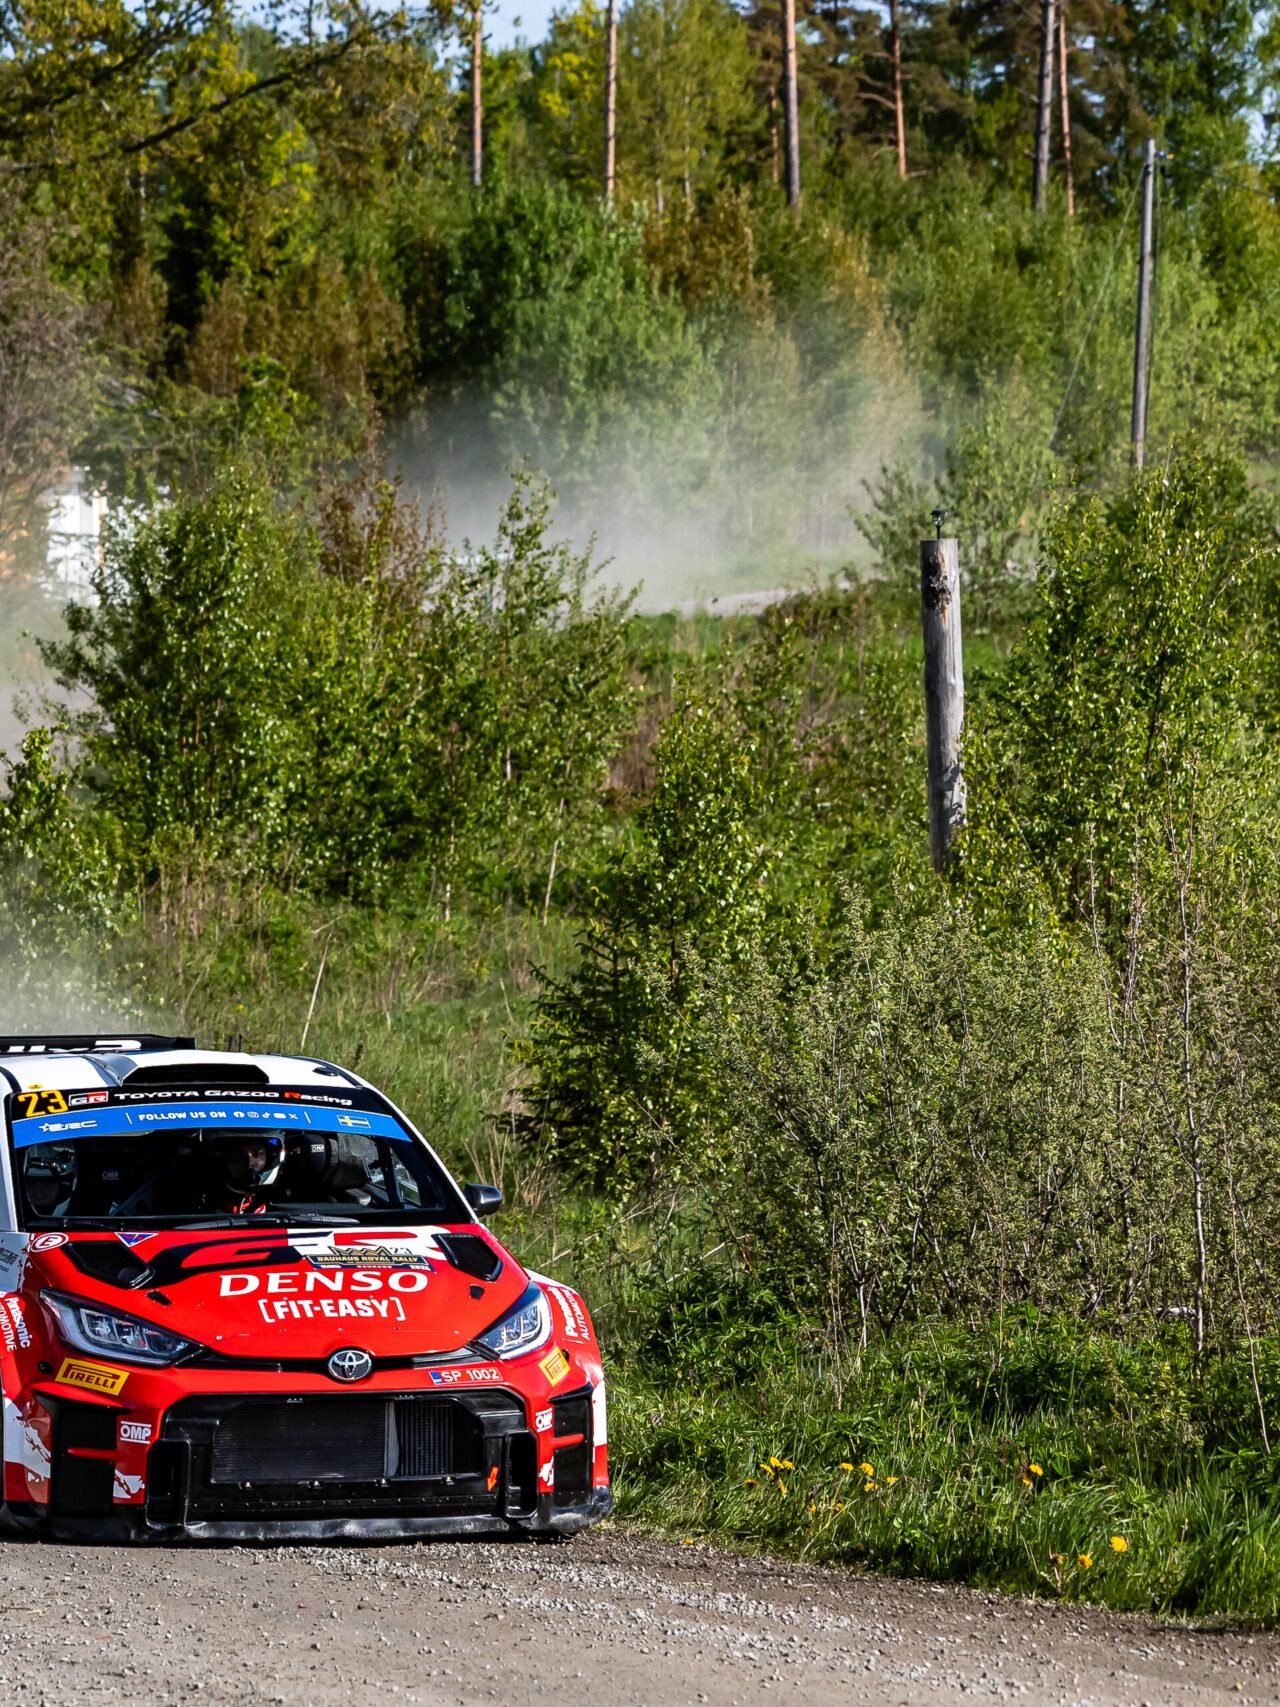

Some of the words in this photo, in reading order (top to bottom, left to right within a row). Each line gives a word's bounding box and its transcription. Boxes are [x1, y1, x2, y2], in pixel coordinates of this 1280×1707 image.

[18, 1090, 69, 1118] 23
[71, 1095, 106, 1105] GR
[114, 1091, 200, 1101] TOYOTA
[204, 1089, 280, 1098] GAZOO
[284, 1091, 352, 1106] Racing
[138, 1112, 187, 1121] FOLLOW
[190, 1111, 207, 1119] US
[220, 1271, 428, 1297] DENSO
[5, 1297, 32, 1348] Panasonic
[548, 1286, 578, 1337] Panasonic
[62, 1363, 120, 1389] PIRELLI
[441, 1370, 461, 1382] SP
[466, 1369, 500, 1380] 1002
[544, 1352, 566, 1380] PIRELLI
[120, 1423, 151, 1441] OMP
[535, 1411, 552, 1430] OMP
